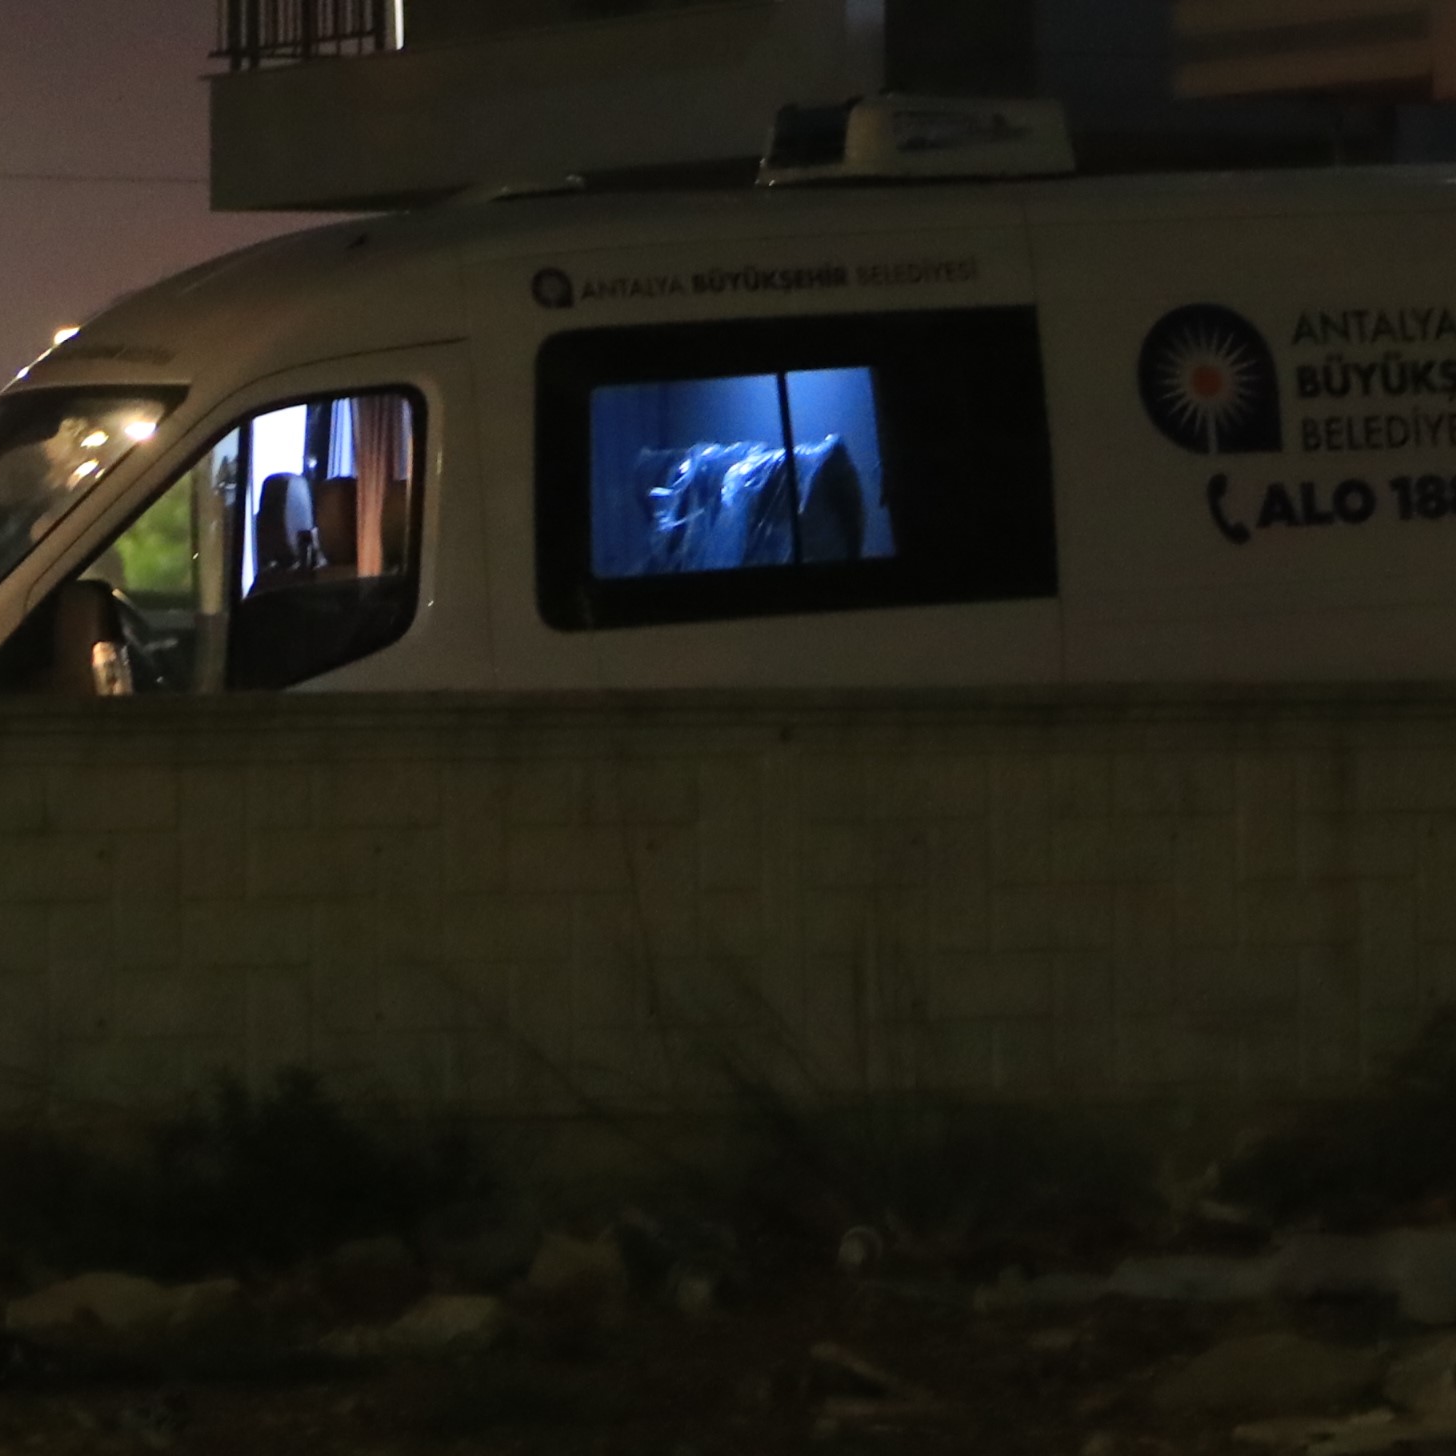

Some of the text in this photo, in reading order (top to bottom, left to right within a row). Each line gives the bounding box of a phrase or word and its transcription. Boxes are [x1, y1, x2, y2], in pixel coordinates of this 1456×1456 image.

[581, 275, 685, 300] ANTALYA
[691, 260, 848, 295] BÜYÜKŞEHİR
[1256, 479, 1376, 528] ALO
